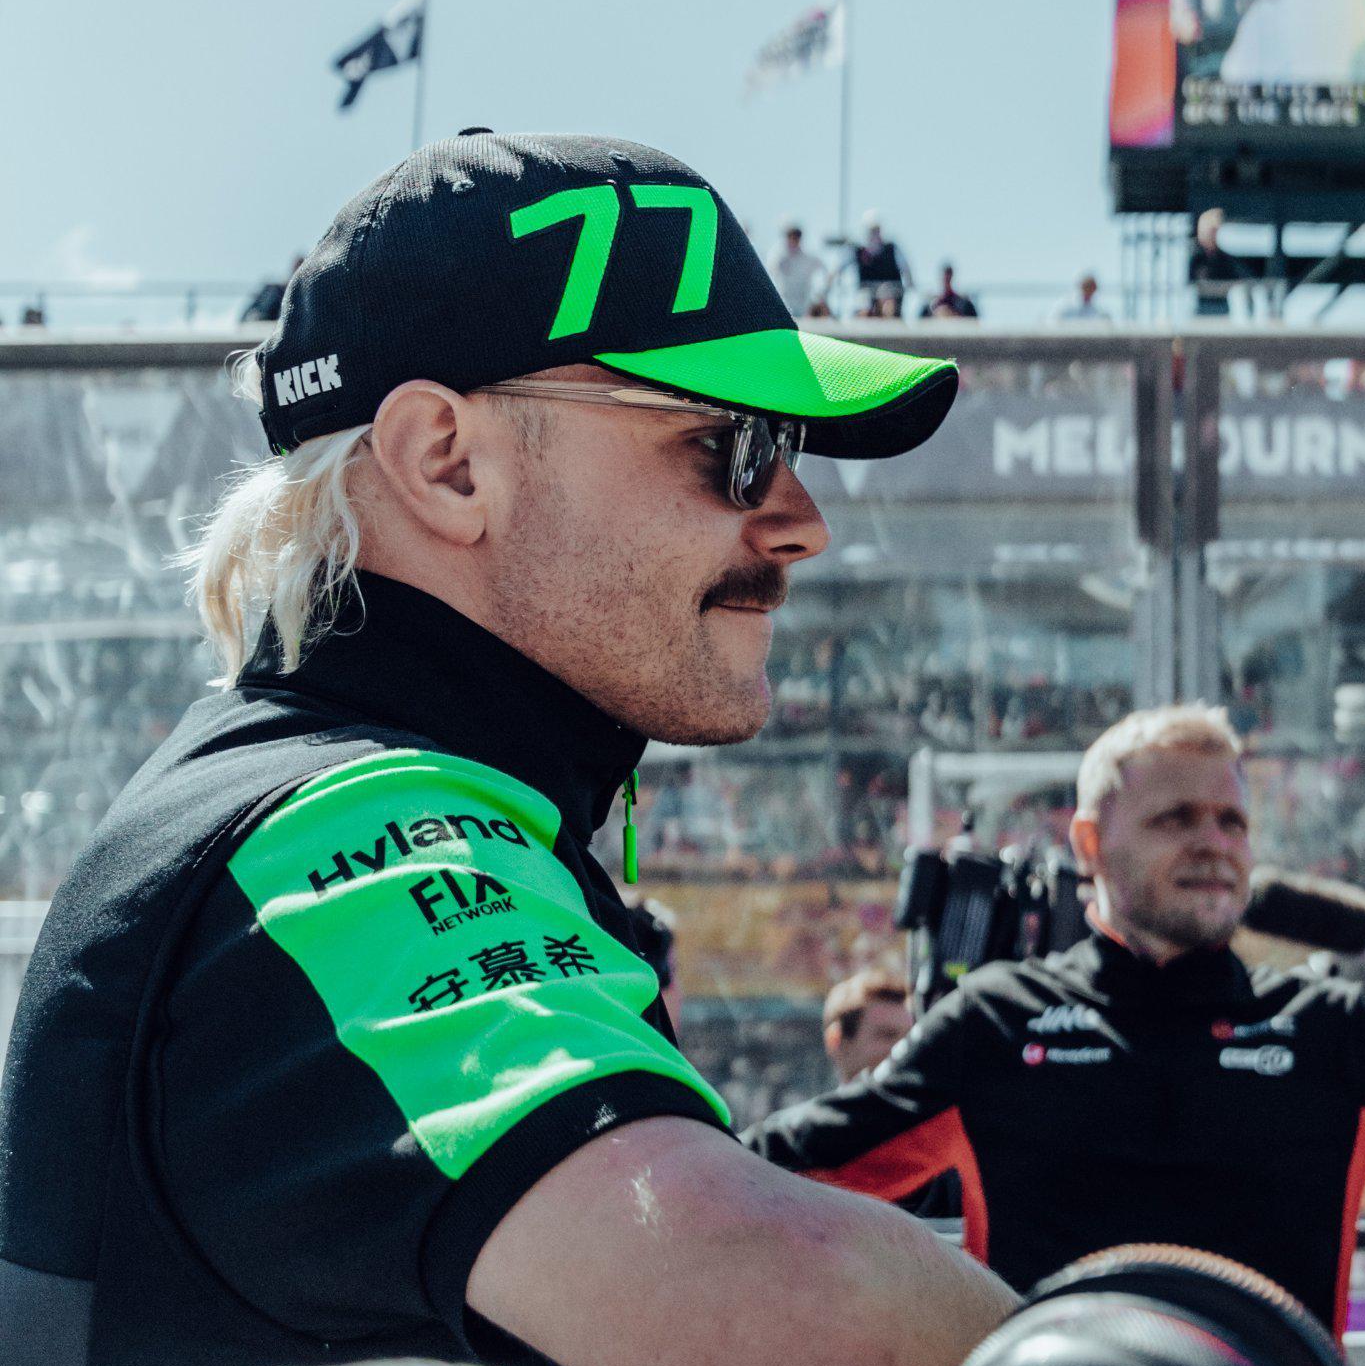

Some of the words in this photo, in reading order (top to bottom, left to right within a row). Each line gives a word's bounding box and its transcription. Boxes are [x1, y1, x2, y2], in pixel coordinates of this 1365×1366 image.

[511, 183, 718, 340] 77
[273, 353, 342, 407] KICK
[307, 814, 530, 899] Hyland
[431, 895, 518, 937] NETWORK
